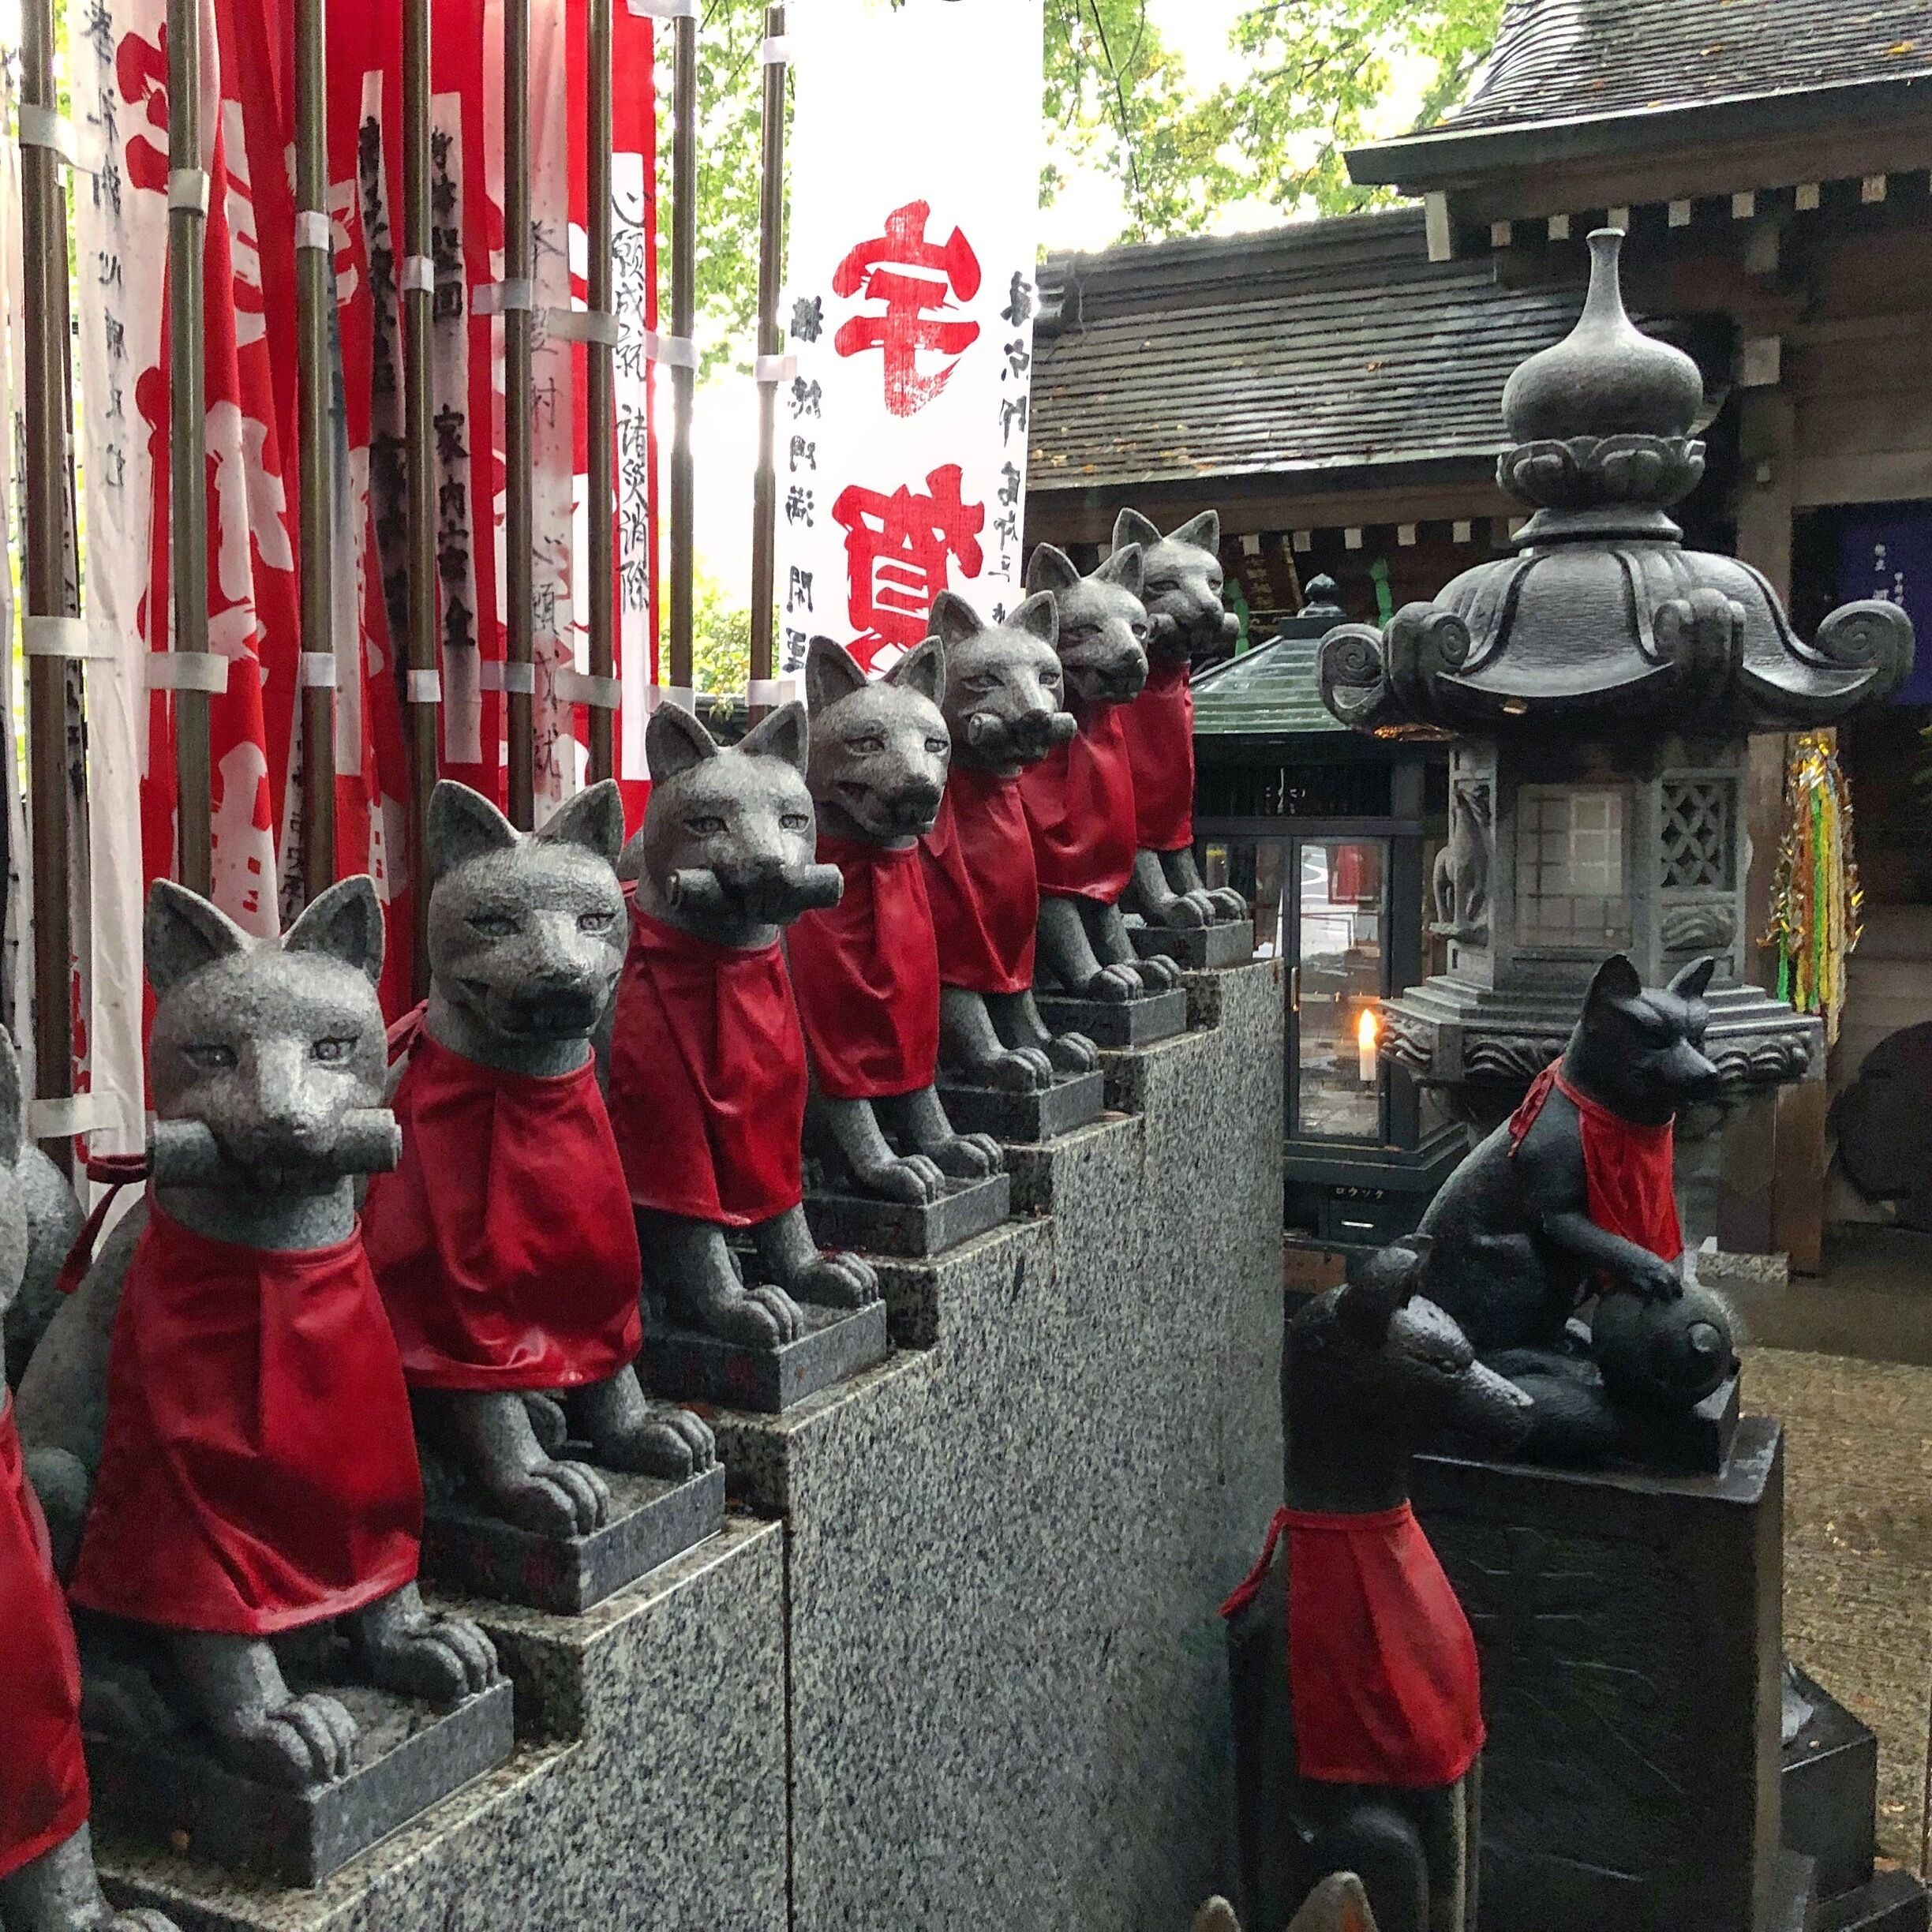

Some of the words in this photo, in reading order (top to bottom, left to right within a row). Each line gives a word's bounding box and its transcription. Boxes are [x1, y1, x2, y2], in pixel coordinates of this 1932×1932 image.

[611, 191, 651, 380] 心願成就
[433, 403, 476, 646] 家内安全
[617, 404, 650, 613] 諸災消除
